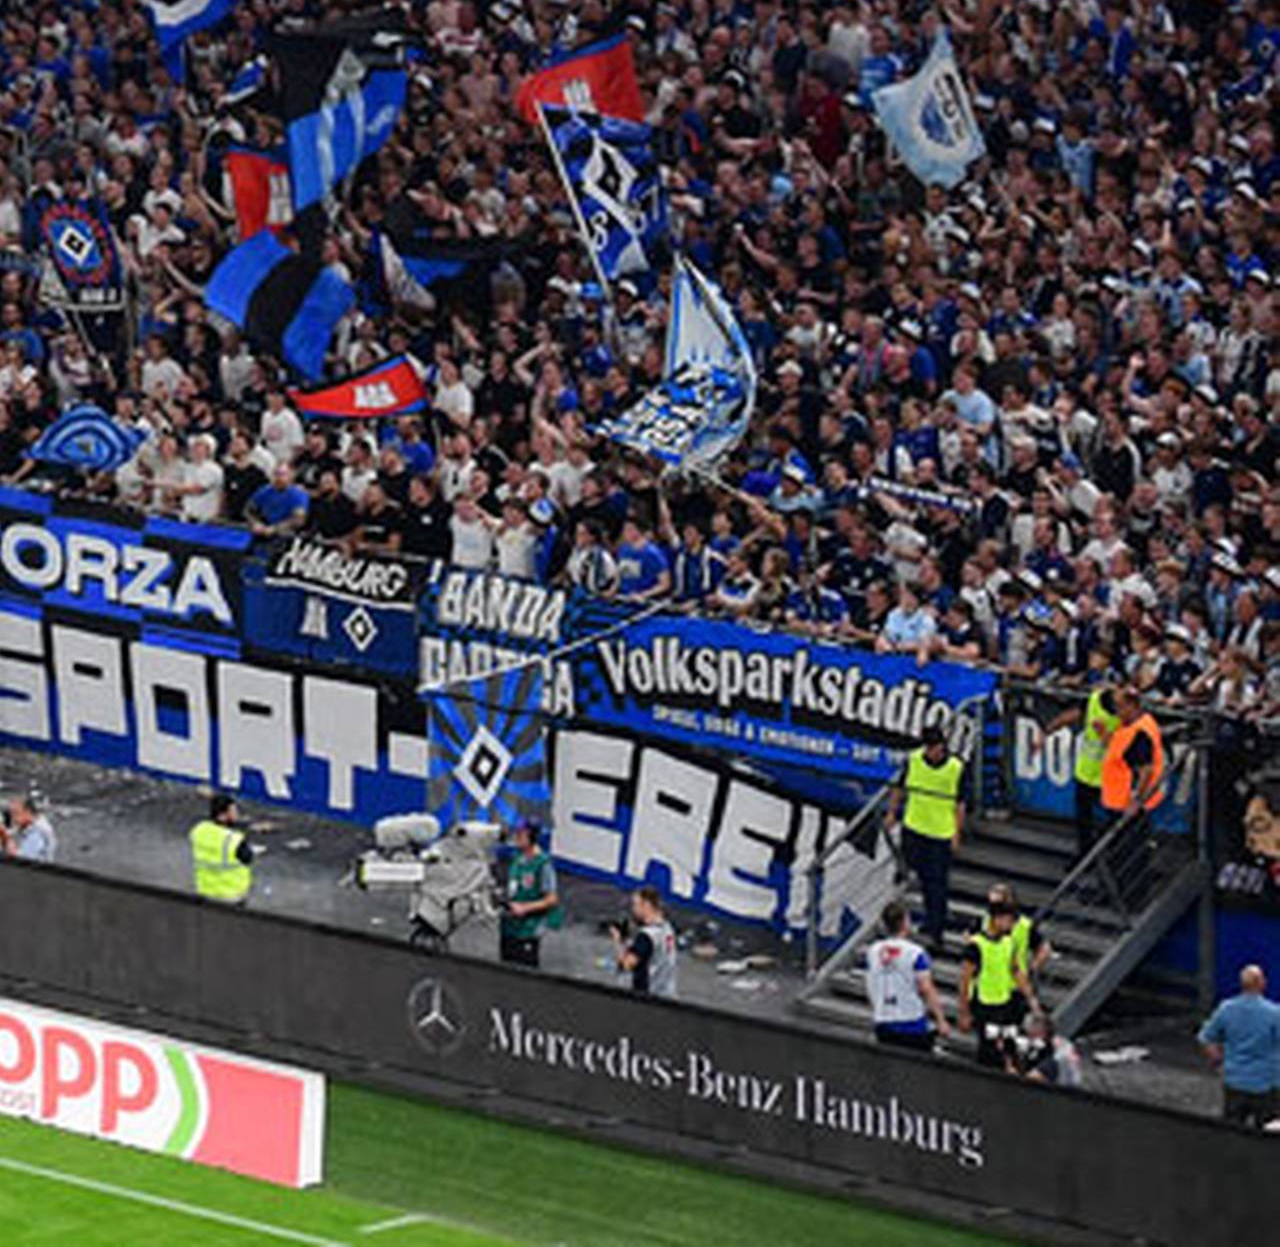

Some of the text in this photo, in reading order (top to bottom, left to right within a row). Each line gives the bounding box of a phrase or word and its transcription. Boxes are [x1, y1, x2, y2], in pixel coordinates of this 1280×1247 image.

[277, 537, 408, 598] HAMBURG
[440, 572, 566, 643] BANDA
[487, 1007, 986, 1168] Mercedes-Benz Hamburg
